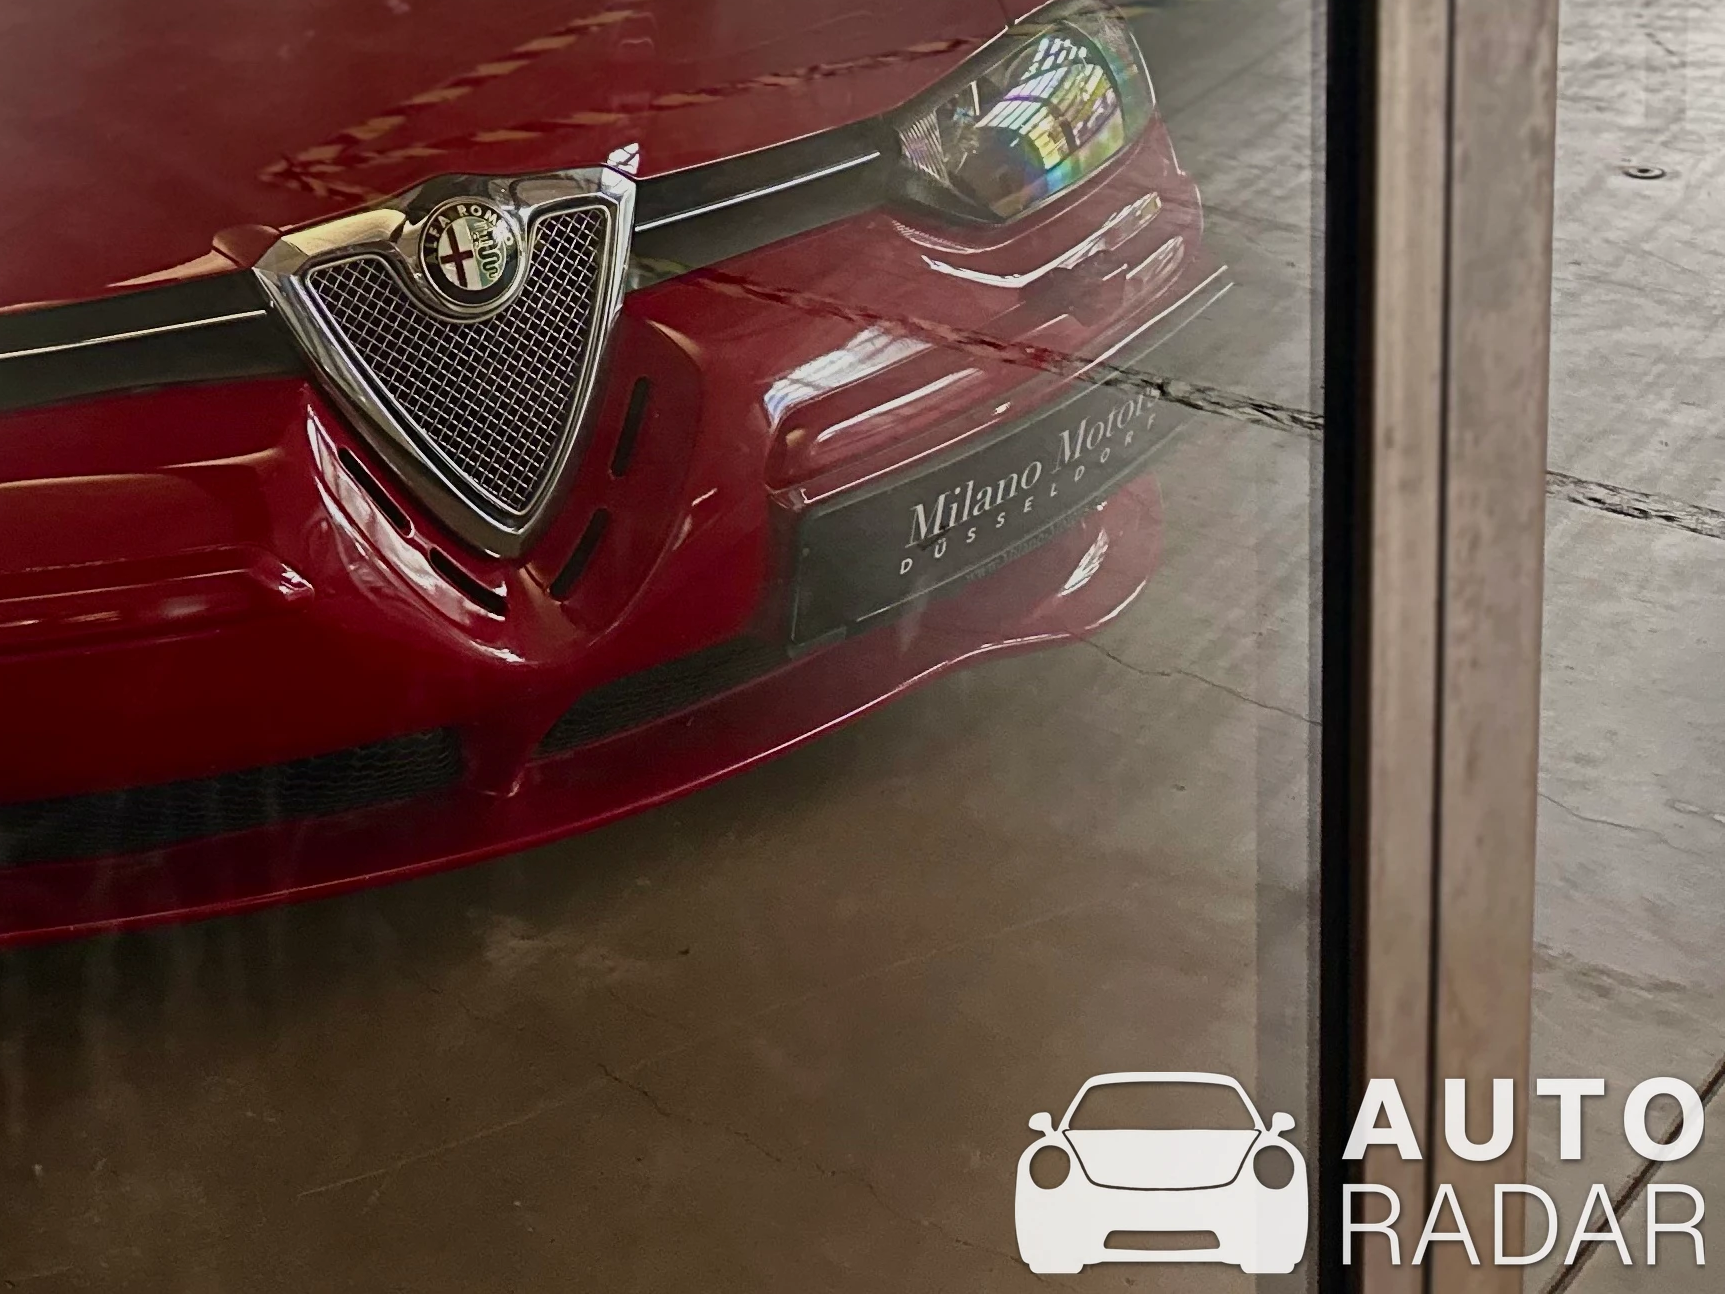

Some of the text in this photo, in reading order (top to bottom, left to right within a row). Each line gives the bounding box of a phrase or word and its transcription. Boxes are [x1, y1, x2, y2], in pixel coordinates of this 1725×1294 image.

[425, 215, 452, 264] ALFA
[899, 413, 1157, 575] DÜSSELDORF
[904, 460, 1044, 550] Milano
